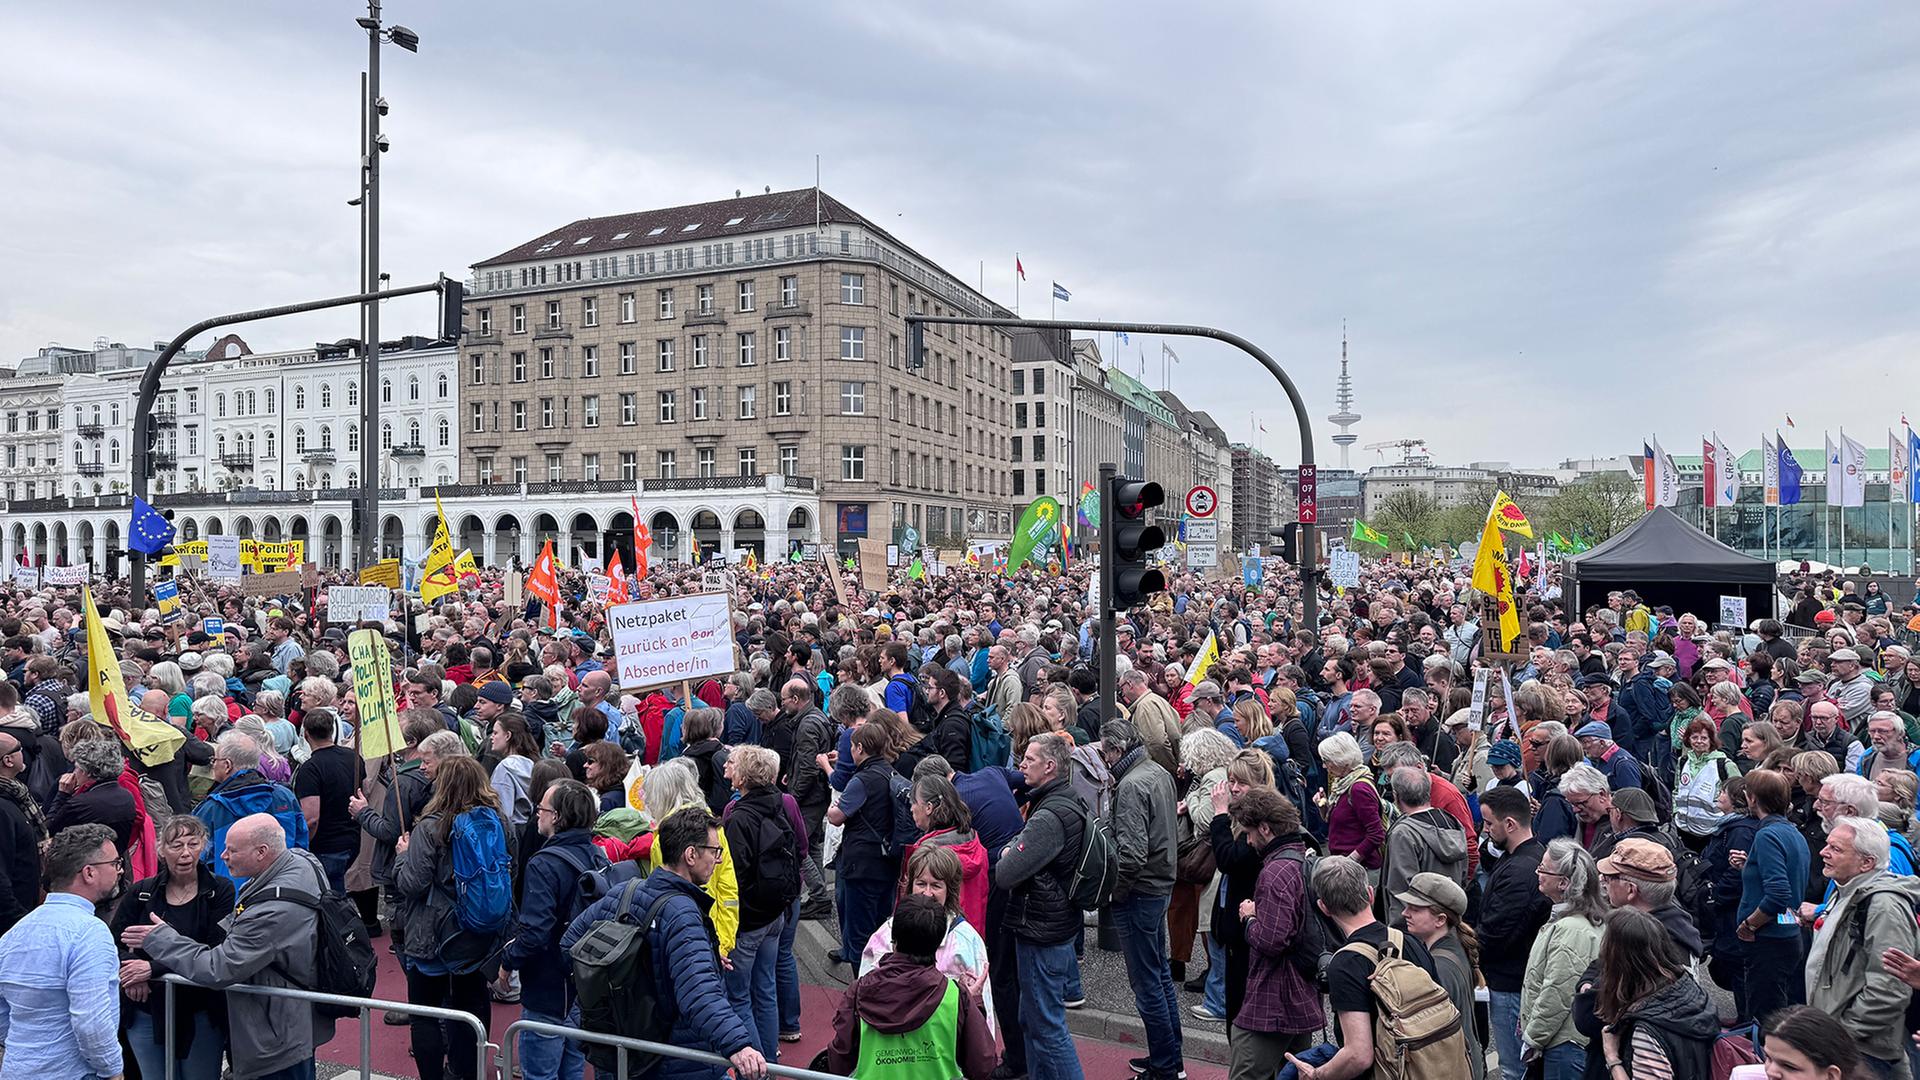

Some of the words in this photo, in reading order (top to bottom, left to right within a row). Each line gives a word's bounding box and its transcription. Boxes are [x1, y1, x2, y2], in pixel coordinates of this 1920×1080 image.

[1301, 468, 1313, 477] 03
[1301, 484, 1313, 493] 07
[1335, 552, 1355, 561] ICH
[1335, 561, 1353, 571] BIN
[1330, 570, 1357, 579] GEGEN
[616, 608, 687, 630] Netzpaket
[621, 636, 667, 656] zurück
[671, 636, 688, 648] an
[1490, 639, 1521, 654] LIIT
[624, 656, 709, 680] Absender/in
[358, 680, 374, 699] NOT
